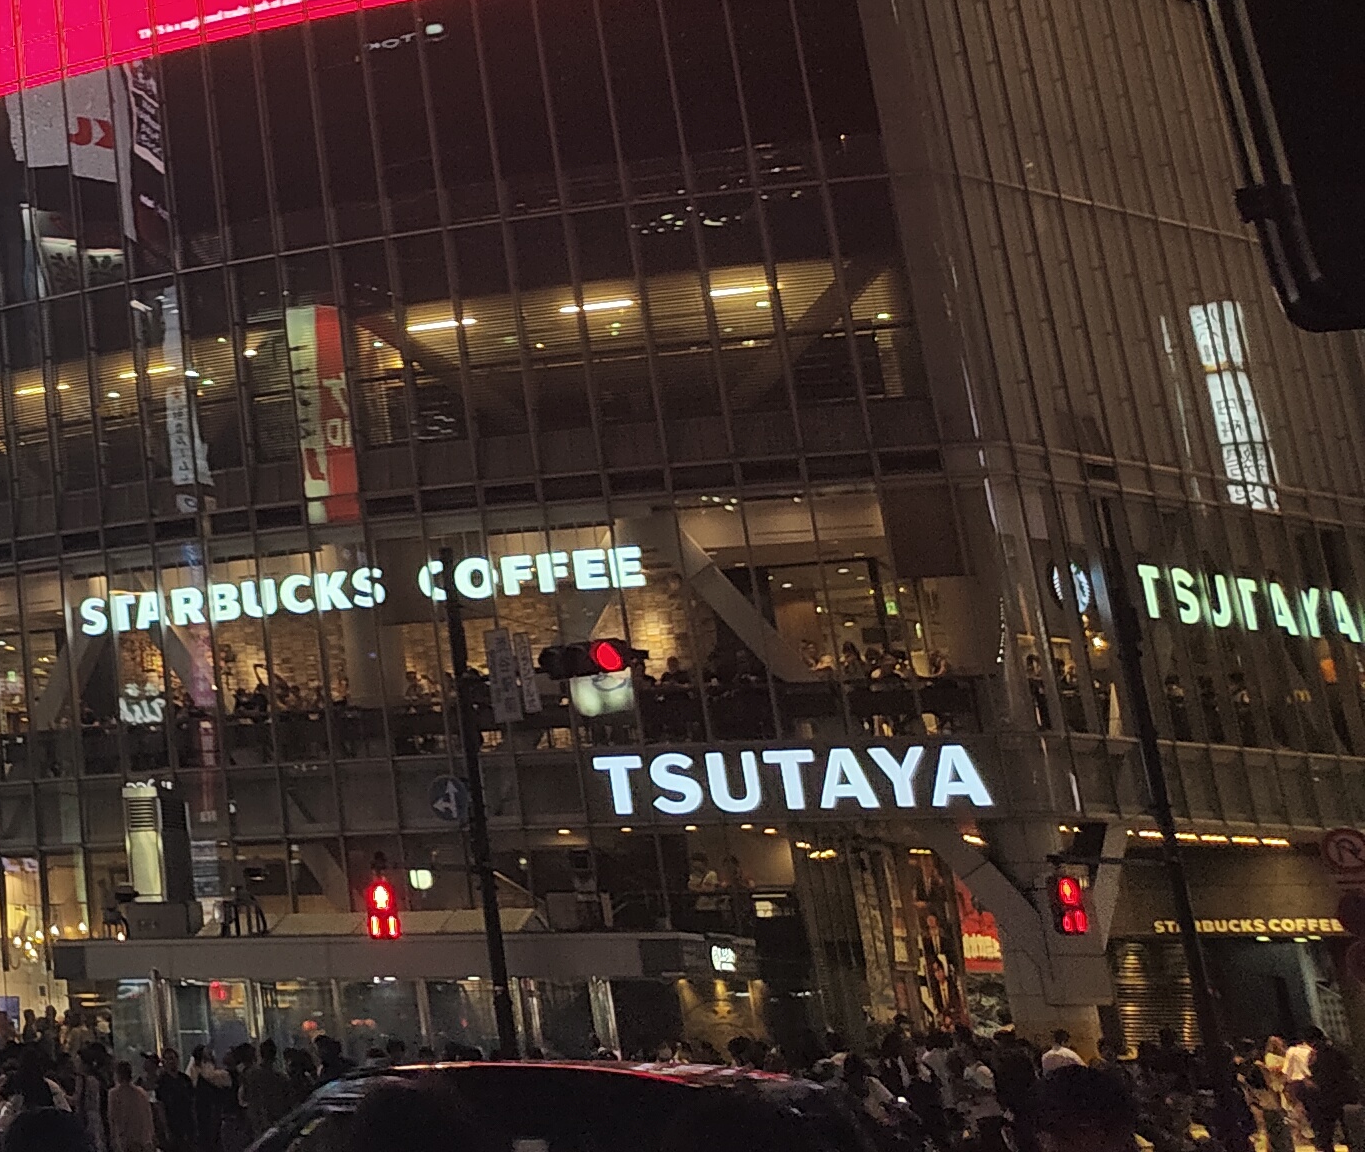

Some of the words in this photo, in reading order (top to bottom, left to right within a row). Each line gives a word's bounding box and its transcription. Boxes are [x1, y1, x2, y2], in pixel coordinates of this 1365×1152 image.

[79, 567, 386, 638] STARBUCKS
[418, 544, 647, 601] COFFEE
[1136, 563, 1365, 646] TSUTAYA
[592, 744, 994, 816] TSUTAYA
[1268, 917, 1344, 932] COFFEE
